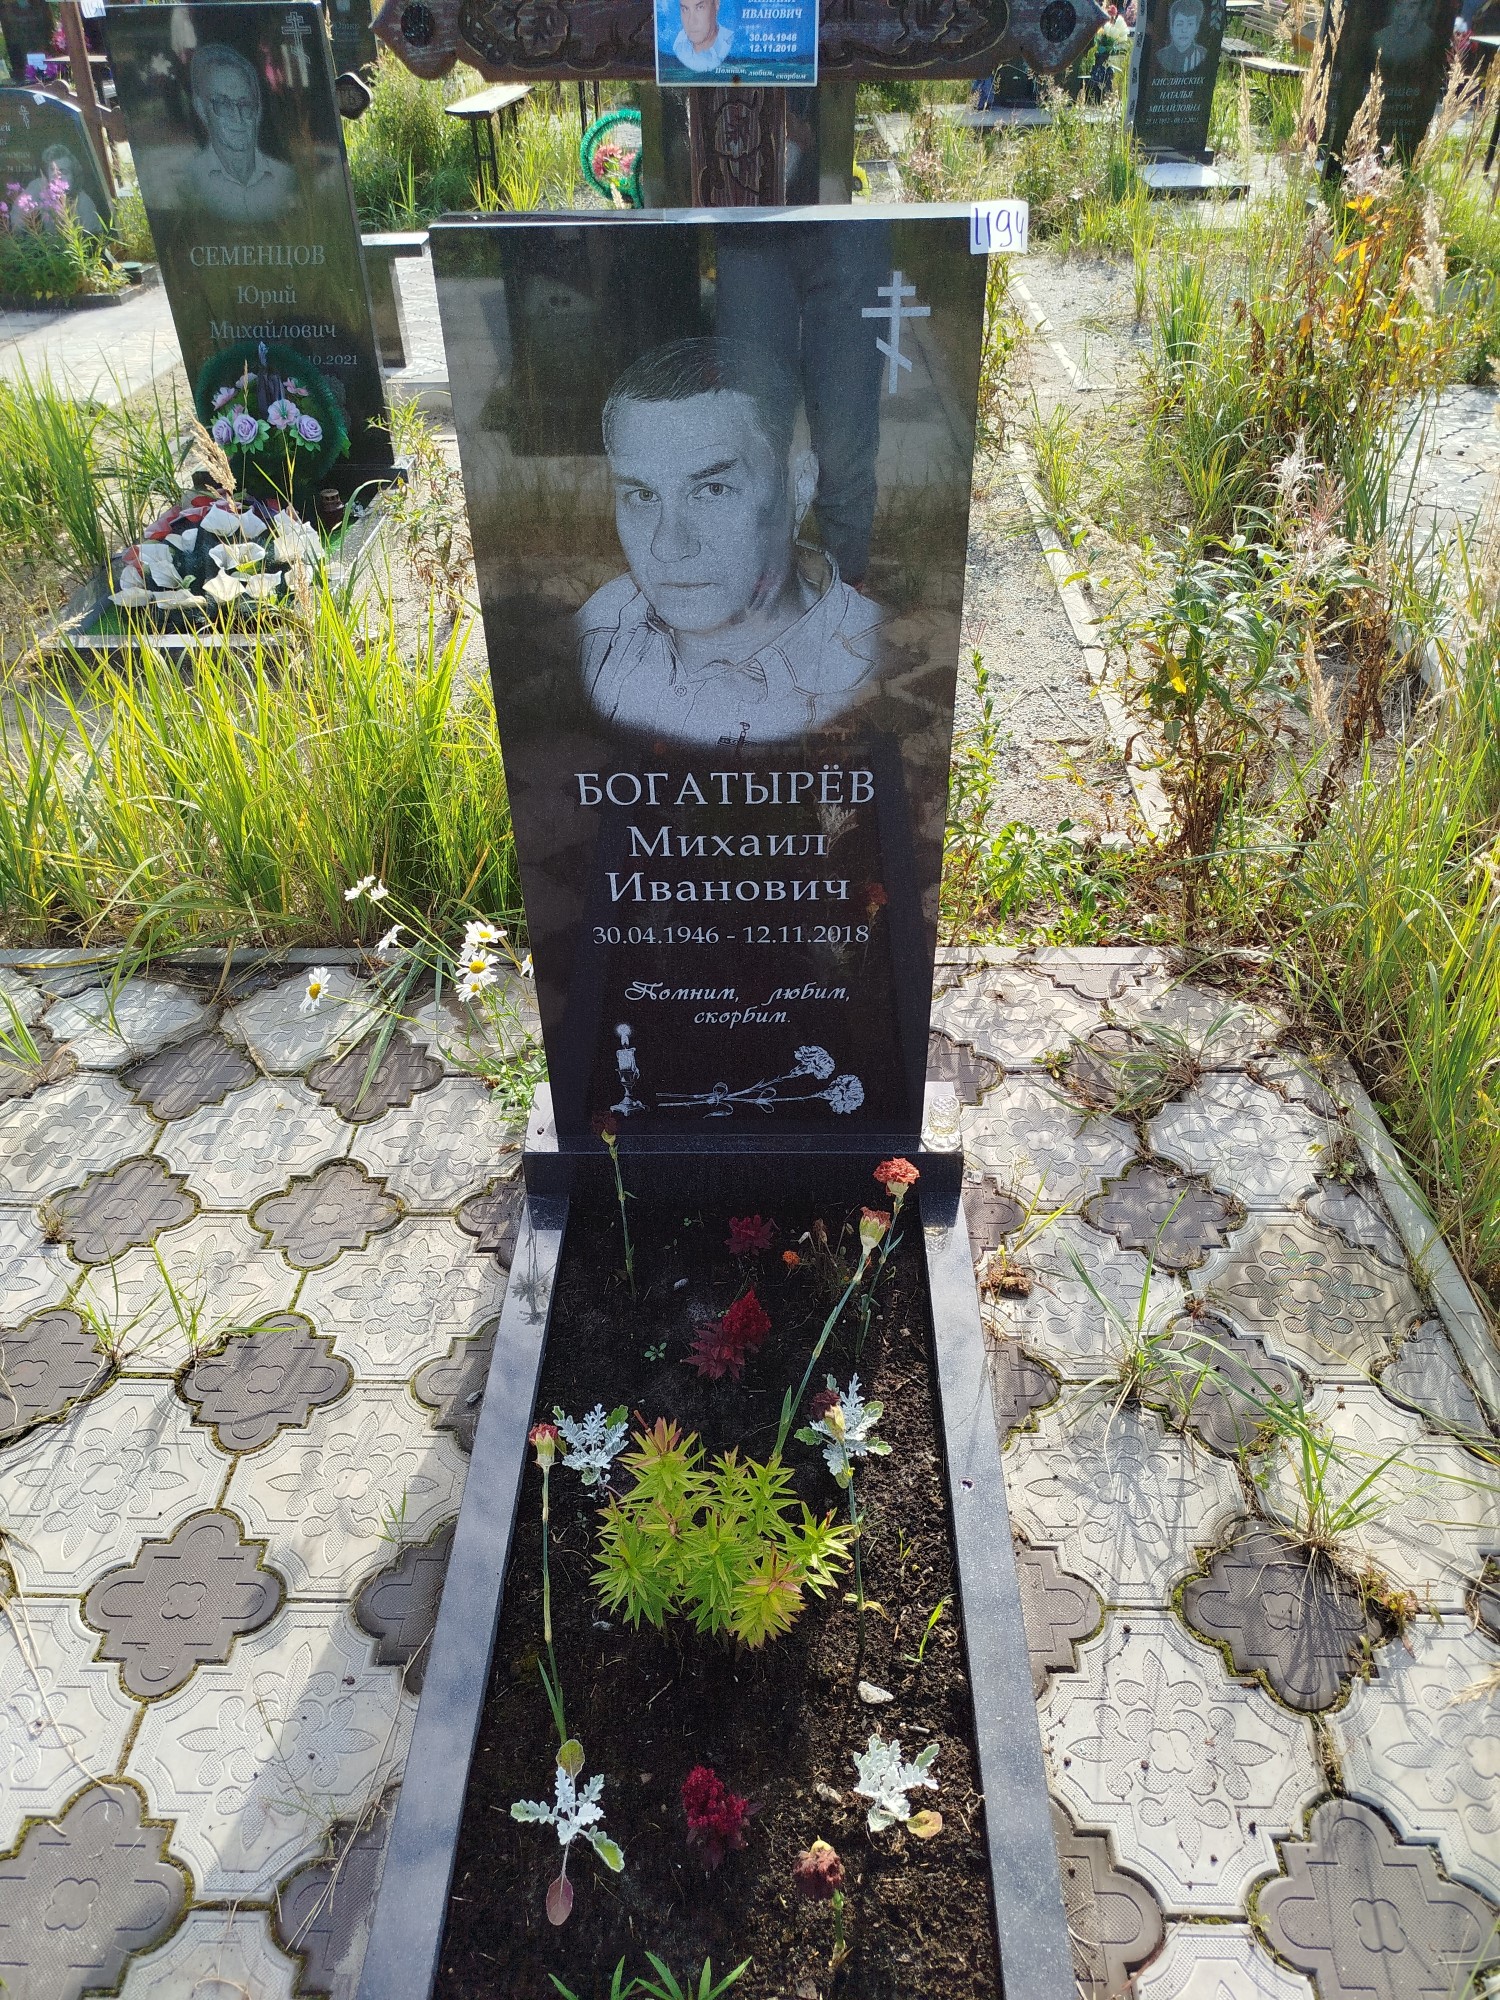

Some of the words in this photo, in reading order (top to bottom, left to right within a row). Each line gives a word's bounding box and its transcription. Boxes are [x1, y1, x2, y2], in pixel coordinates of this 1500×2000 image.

[742, 9, 803, 19] ИВАНОВИЧ
[749, 33, 797, 42] 30.04.1946
[750, 44, 797, 53] 12.11.2018
[1160, 91, 1194, 99] НАТАЛЬЯ
[974, 207, 1025, 248] 1194
[189, 245, 325, 268] СЕМЕНЦОВ
[237, 285, 297, 308] Юрий
[209, 319, 337, 340] Михайлович
[574, 764, 876, 806] БОГАТЫРЁВ
[626, 826, 829, 857] Михаил
[604, 872, 851, 902] Иванович
[592, 926, 719, 945] 30.04.1946
[742, 925, 870, 944] 12.11.2018
[624, 981, 740, 1003] Помним,
[760, 981, 850, 1006] любим,
[693, 1007, 792, 1029] скорбим.
